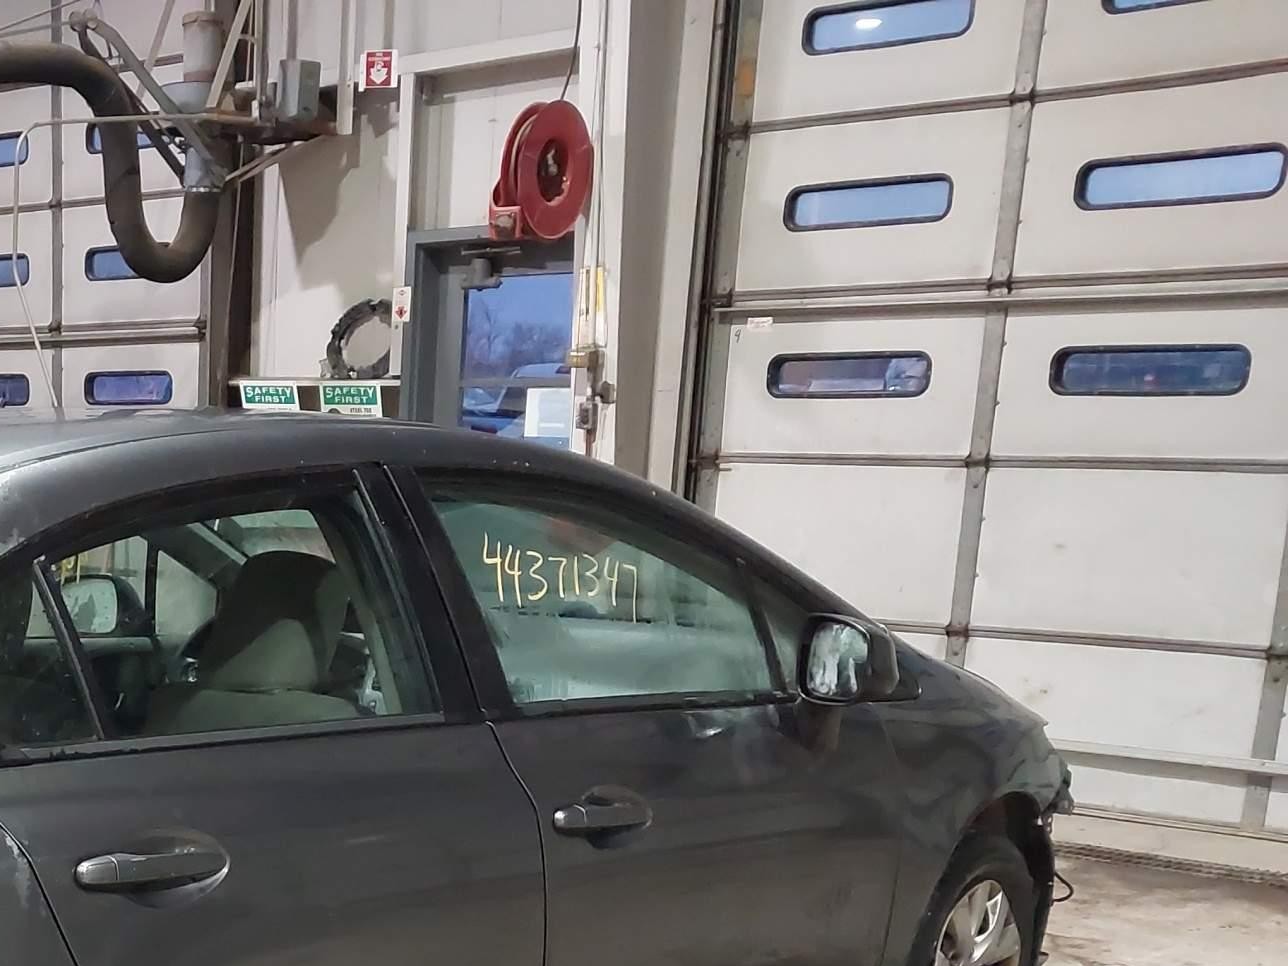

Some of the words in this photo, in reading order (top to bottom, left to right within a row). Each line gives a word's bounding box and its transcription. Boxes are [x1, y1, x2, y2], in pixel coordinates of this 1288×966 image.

[245, 386, 292, 398] SAFETY
[325, 386, 375, 398] SAFETY
[254, 395, 286, 404] FIRST
[334, 395, 368, 404] FIRST
[483, 531, 637, 624] 44371347
